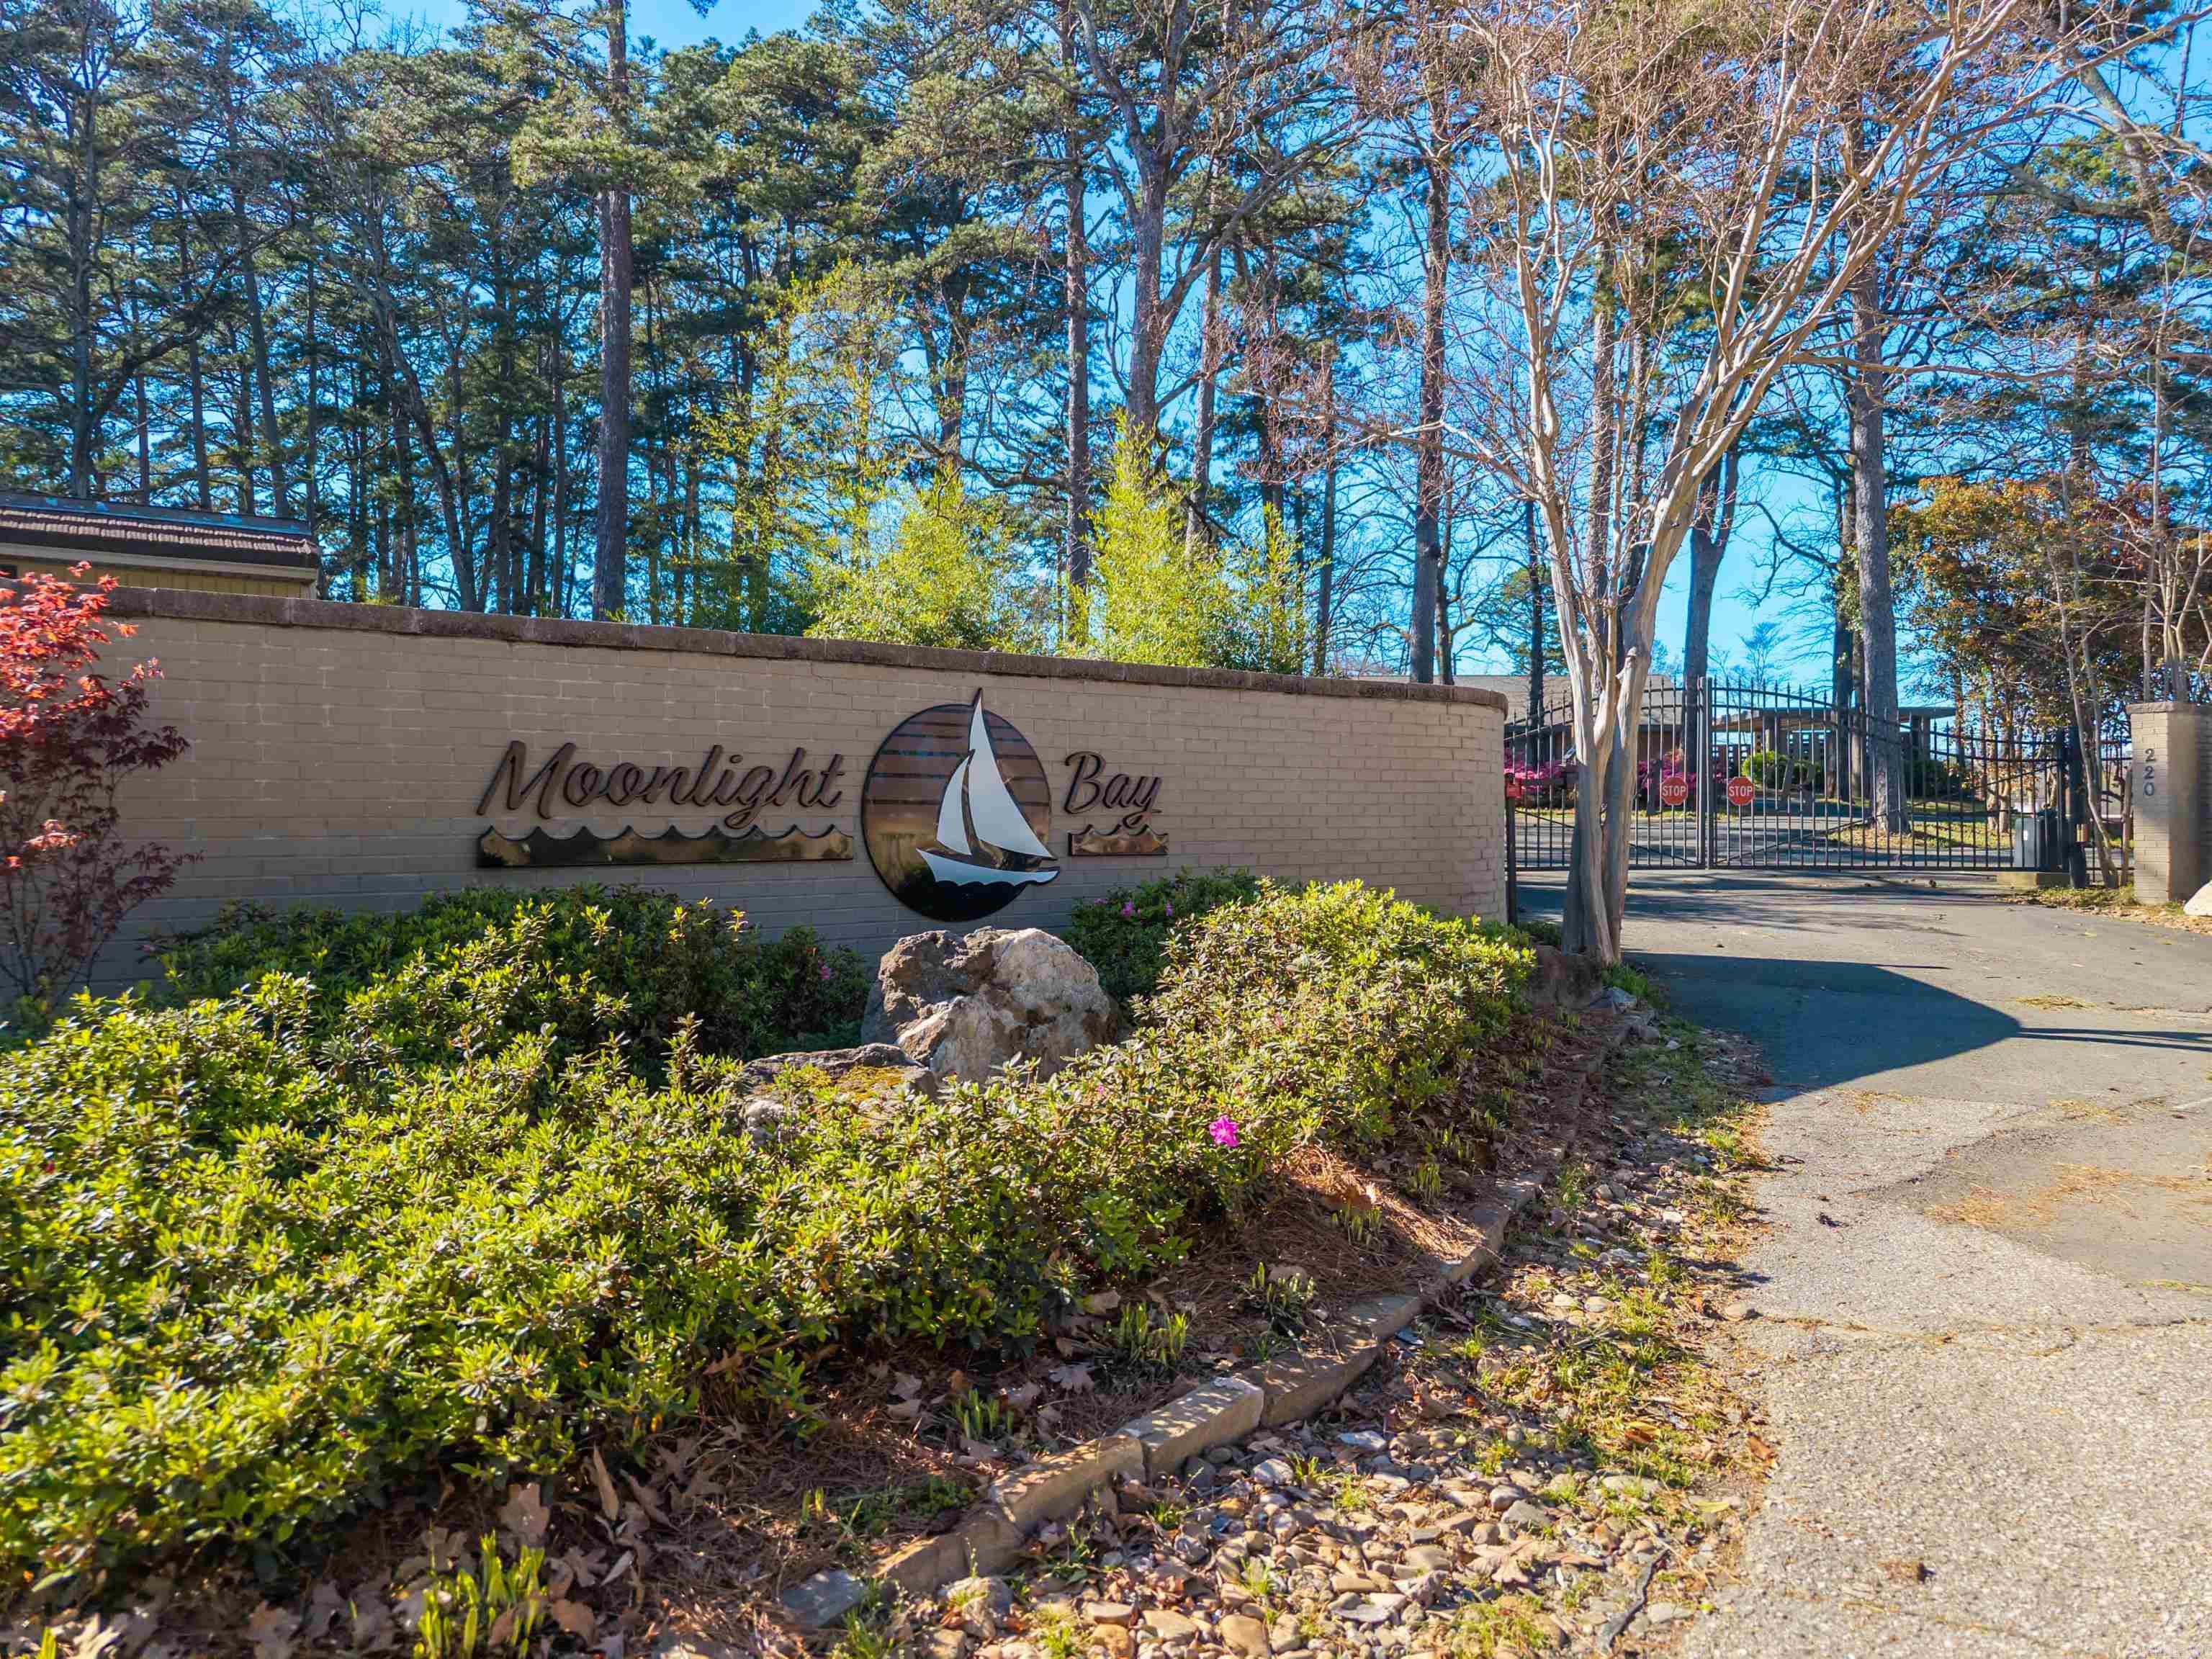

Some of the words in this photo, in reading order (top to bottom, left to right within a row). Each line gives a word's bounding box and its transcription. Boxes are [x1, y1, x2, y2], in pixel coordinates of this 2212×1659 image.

[477, 739, 845, 830] Moonlight
[1064, 750, 1162, 829] Bay
[2144, 749, 2156, 796] 220
[1662, 785, 1686, 796] STOP
[1728, 785, 1753, 796] STOP
